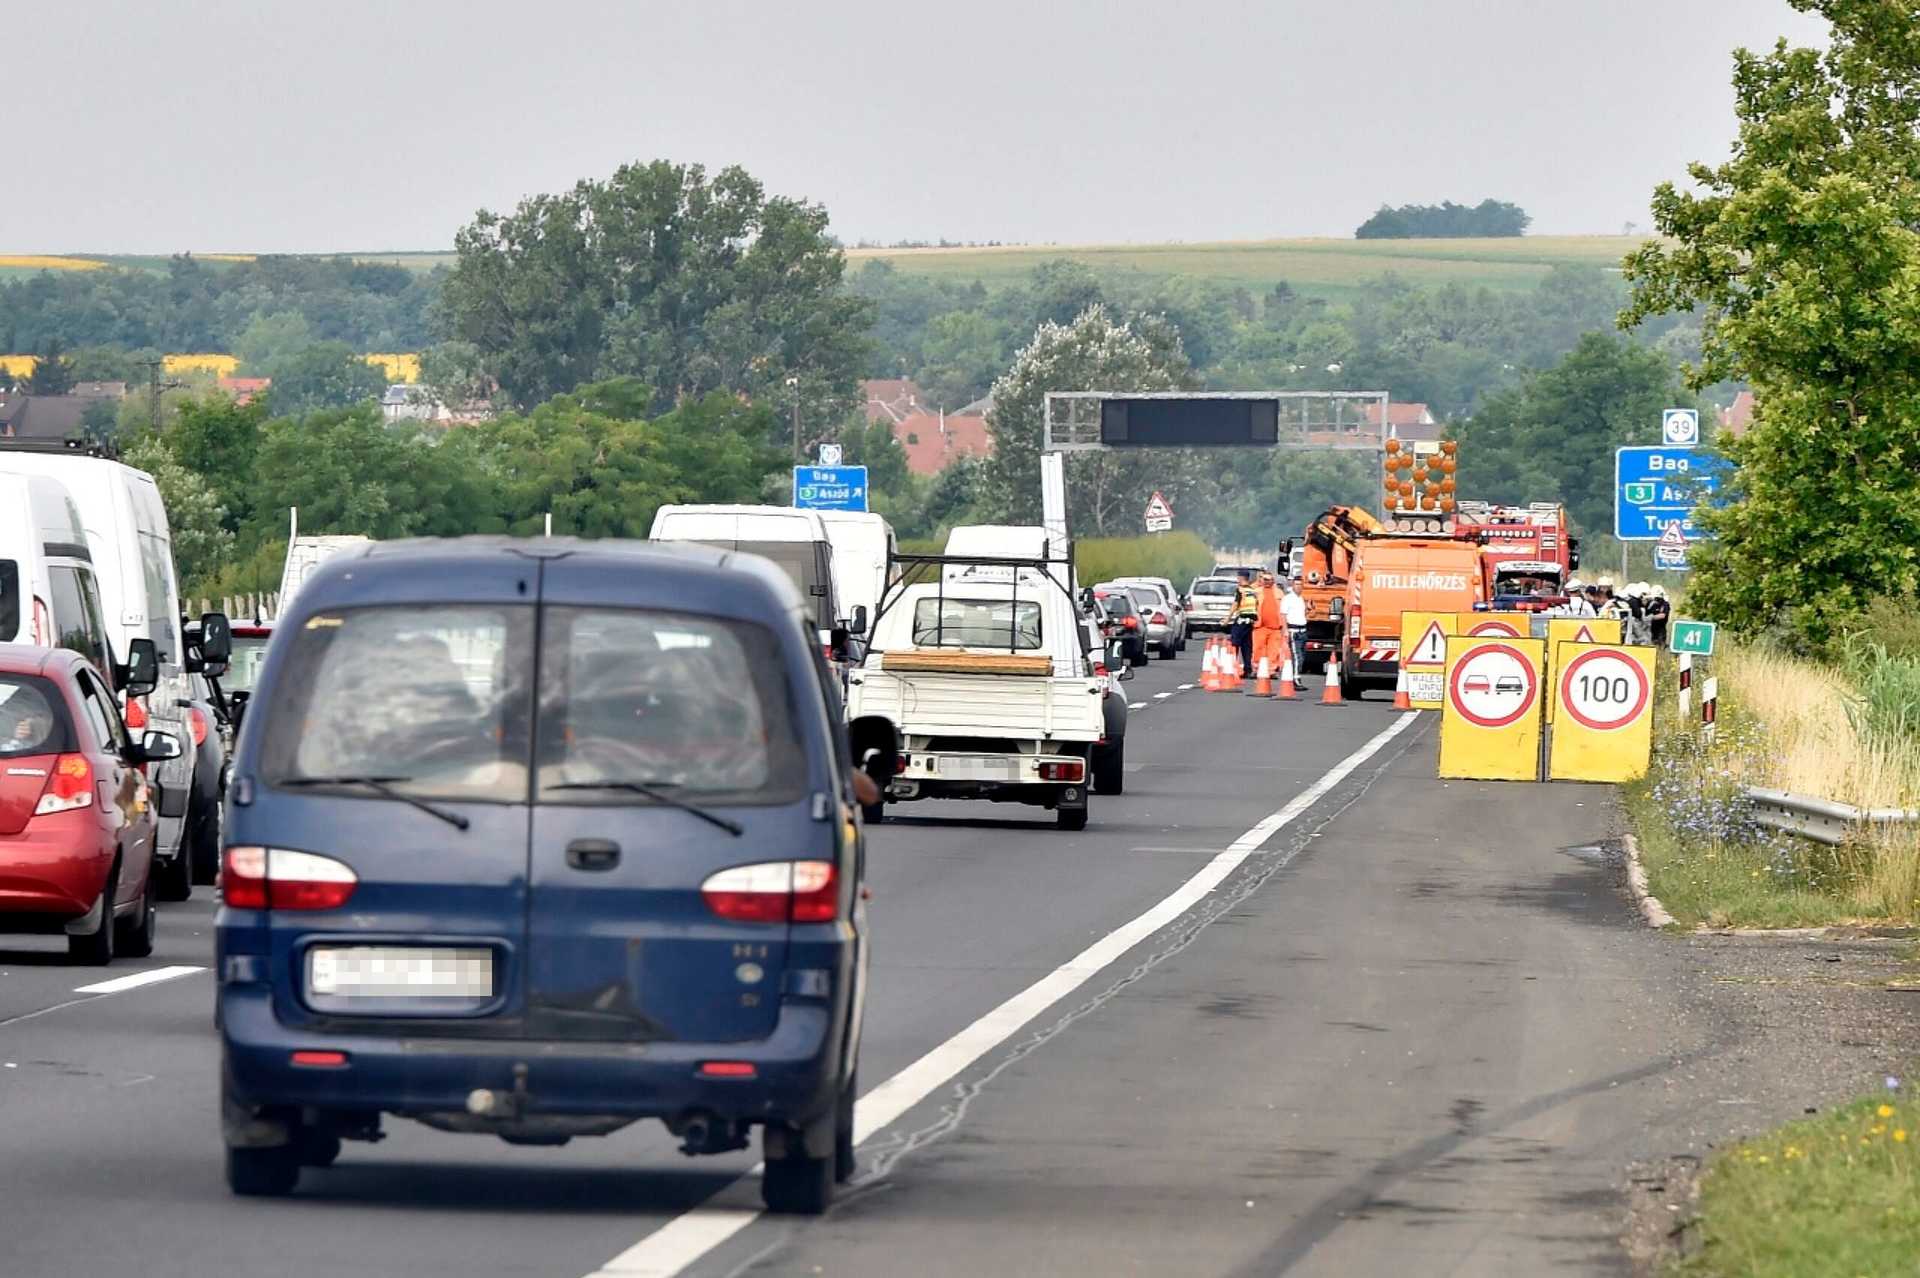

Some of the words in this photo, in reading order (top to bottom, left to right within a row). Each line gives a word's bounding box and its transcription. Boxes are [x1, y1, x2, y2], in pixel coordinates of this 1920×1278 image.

[1671, 420, 1691, 434] 39
[1649, 455, 1689, 474] Bag
[1635, 486, 1646, 500] 3
[1683, 630, 1702, 646] 41
[1579, 675, 1629, 703] 100
